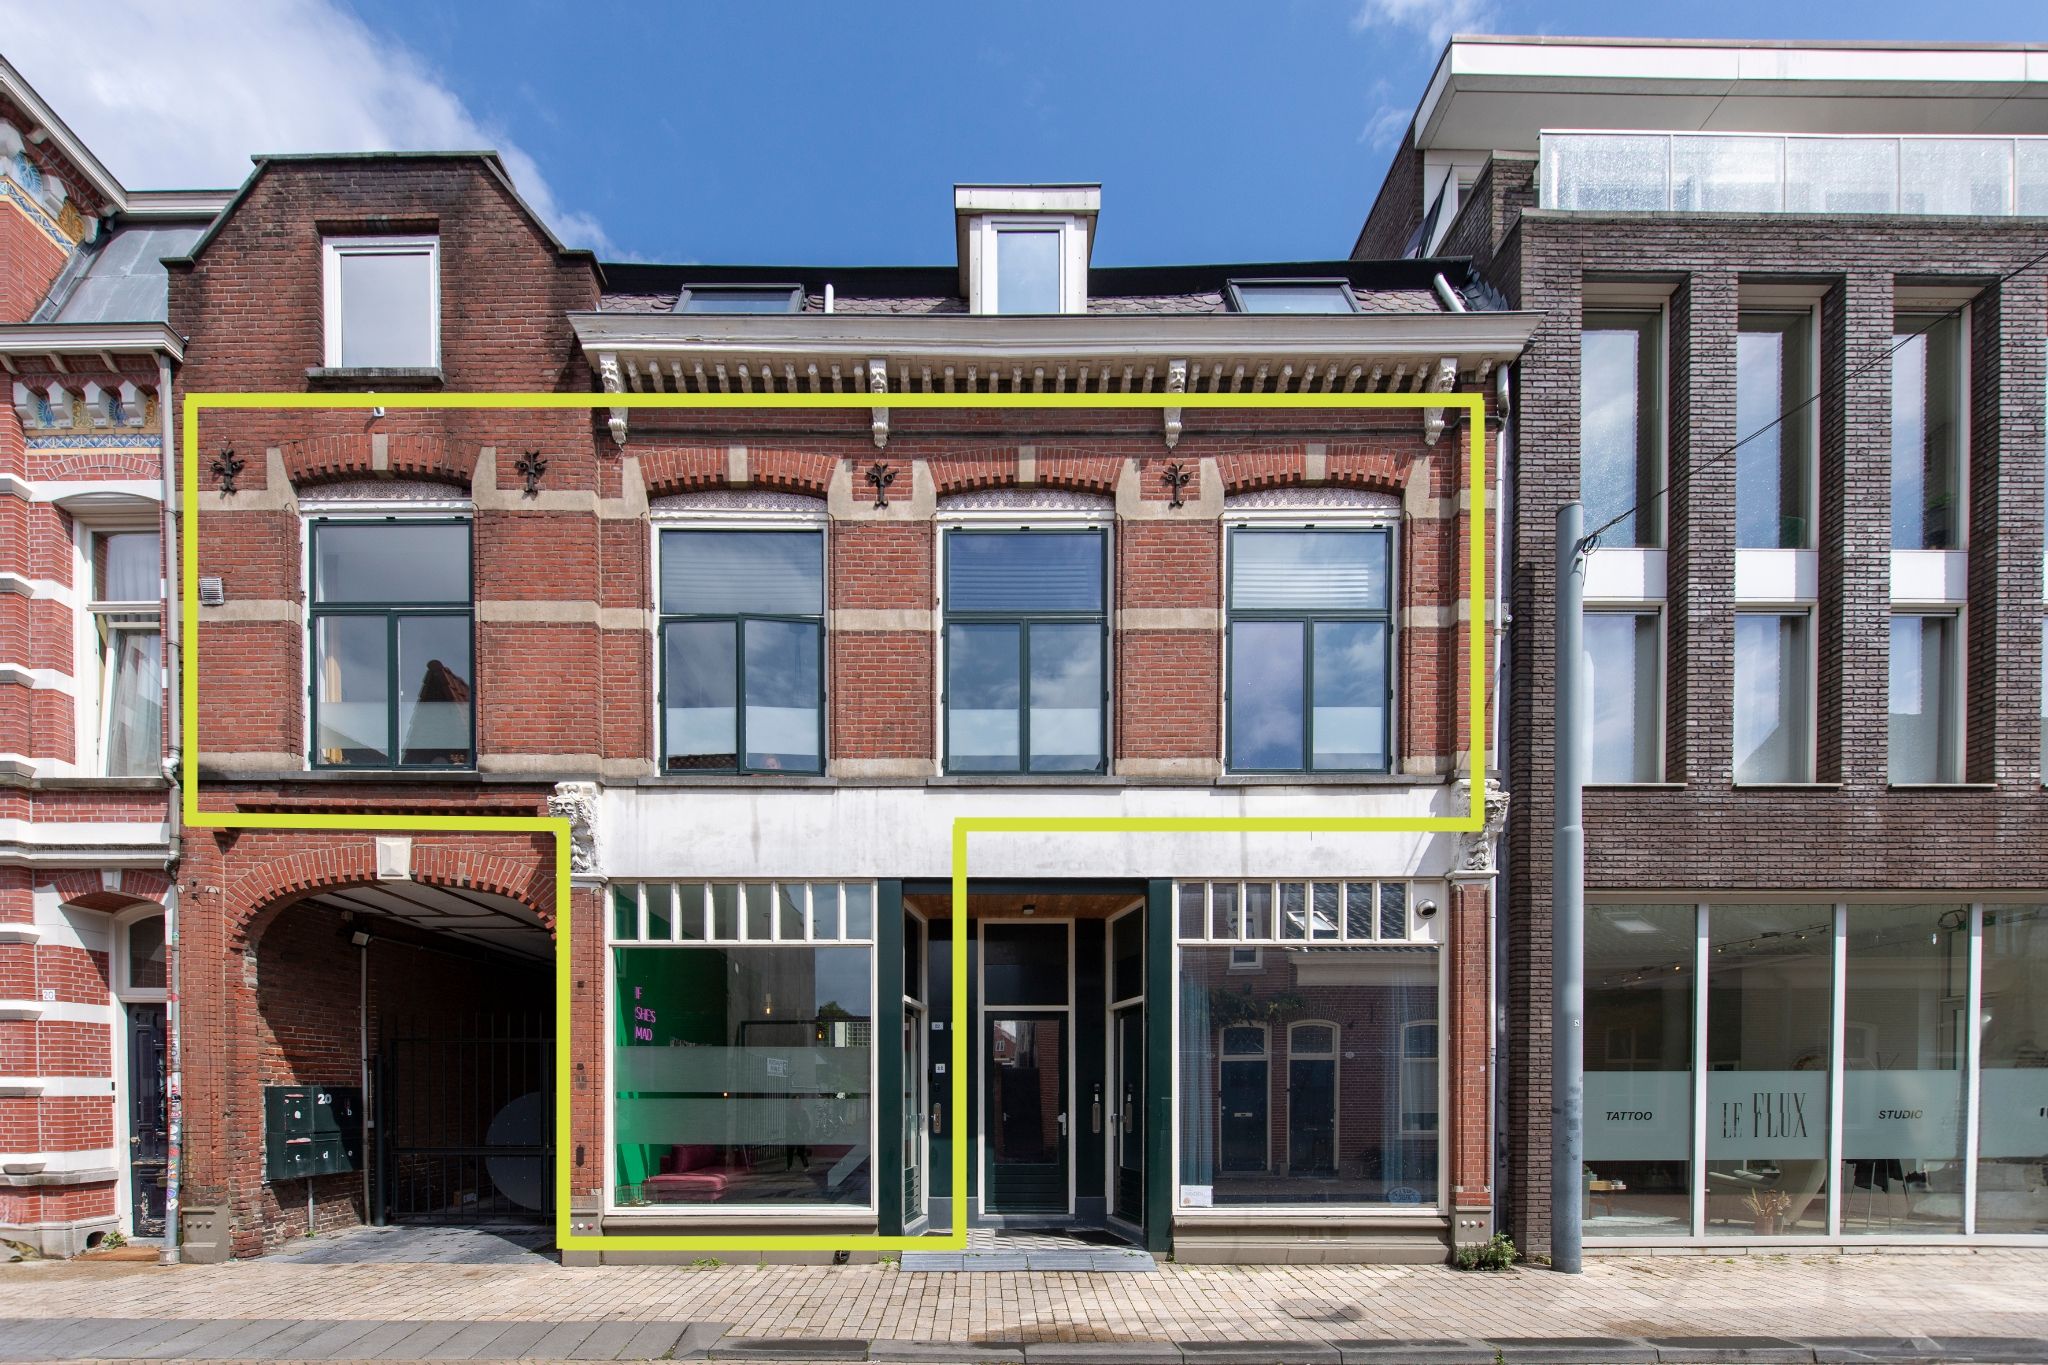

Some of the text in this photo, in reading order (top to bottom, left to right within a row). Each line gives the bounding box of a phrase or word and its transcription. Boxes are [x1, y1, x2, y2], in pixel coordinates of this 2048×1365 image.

[635, 987, 642, 999] IF
[635, 1026, 652, 1040] MAD
[318, 1094, 332, 1104] 20
[347, 1108, 352, 1116] b
[1605, 1112, 1652, 1121] TATTOO
[1721, 1092, 1808, 1139] LE FLUX
[1878, 1110, 1924, 1121] STUDIO
